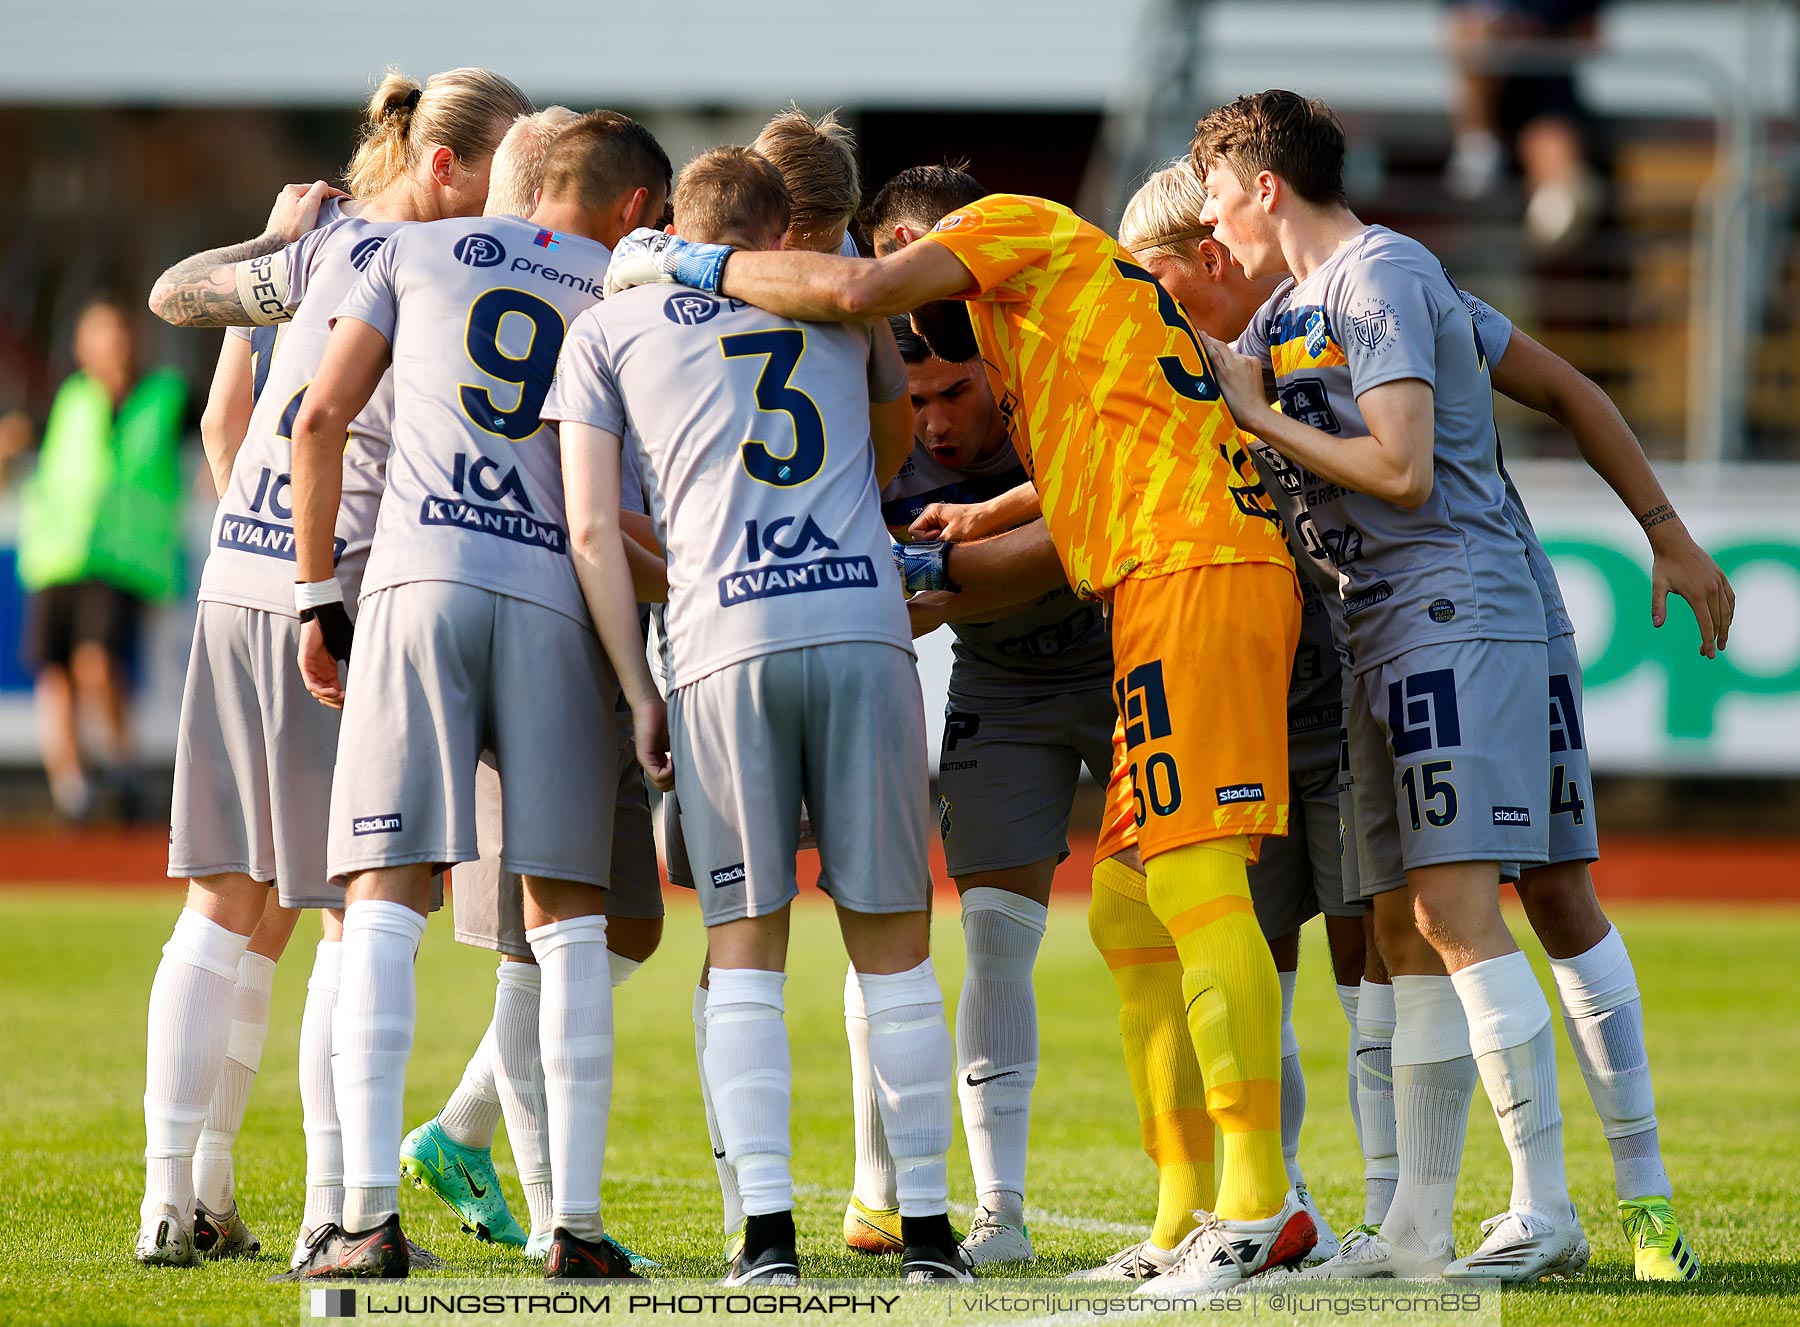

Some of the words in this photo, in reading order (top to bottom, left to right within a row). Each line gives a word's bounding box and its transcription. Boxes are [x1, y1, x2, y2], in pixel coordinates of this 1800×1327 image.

[457, 286, 568, 443] 9
[718, 328, 827, 489] 3
[453, 453, 535, 514] ICA
[427, 500, 559, 547] KVANTUM
[745, 513, 840, 562] ICA
[725, 561, 869, 599] KVANTUM
[1219, 786, 1262, 801] stadium
[1401, 760, 1459, 832] 15
[354, 818, 399, 832] stadium
[1494, 810, 1529, 822] stadium
[770, 1273, 797, 1286] NIKE
[905, 1271, 934, 1285] NIKE
